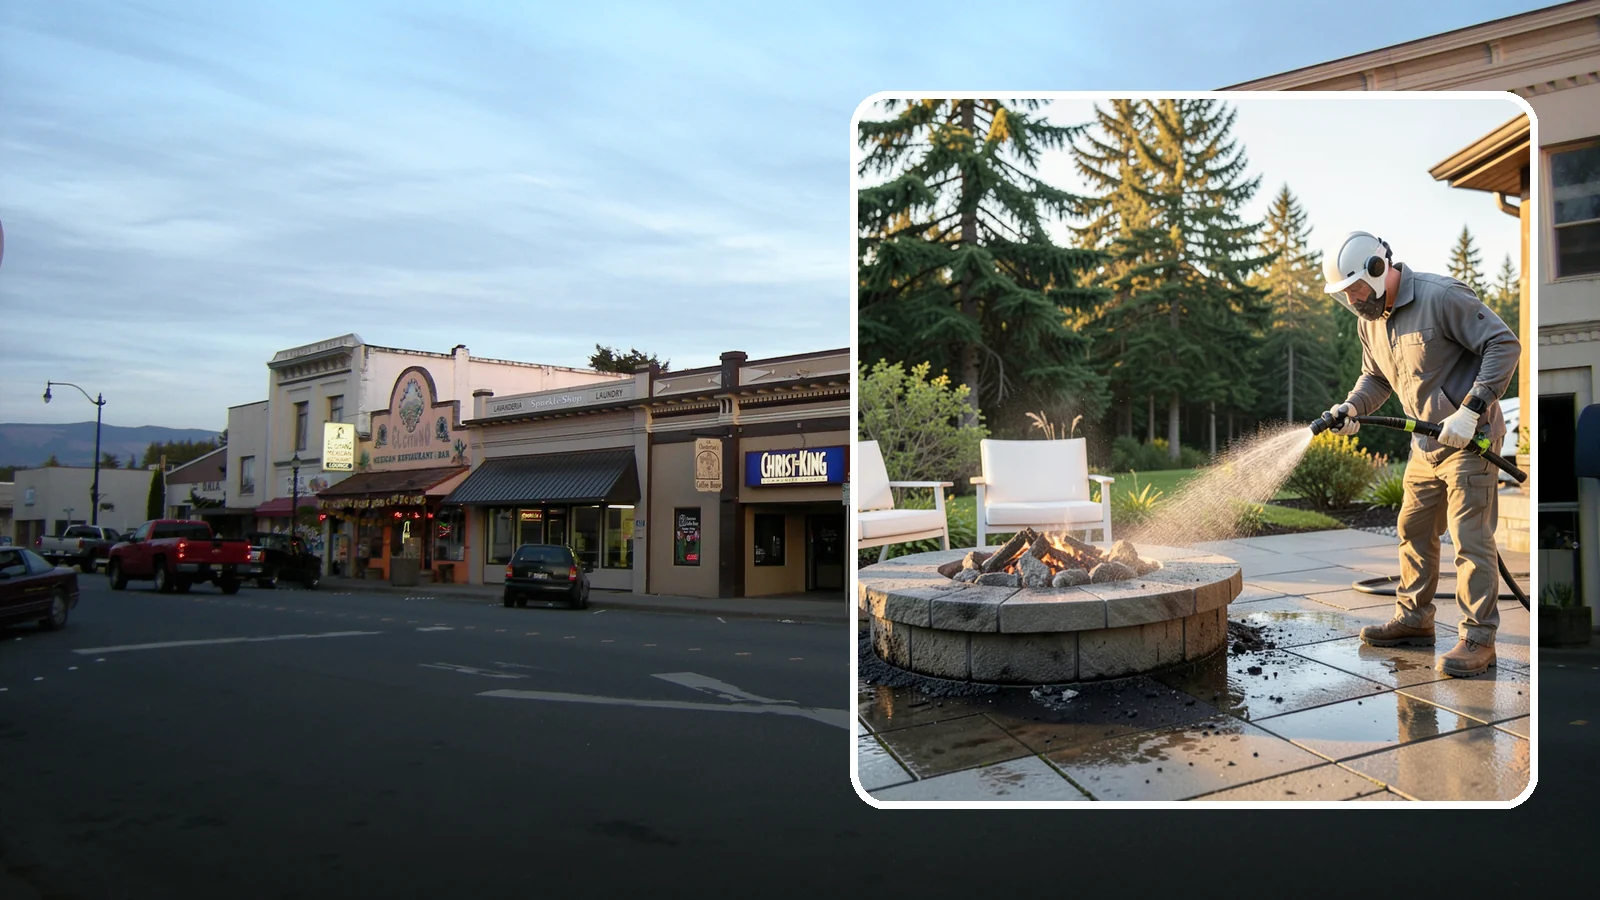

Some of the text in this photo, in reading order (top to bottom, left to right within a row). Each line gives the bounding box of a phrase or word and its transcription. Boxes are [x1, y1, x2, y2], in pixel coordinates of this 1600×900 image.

[493, 389, 623, 412] LAVANDERIA Sparkle Shop LAUNDRY
[374, 455, 396, 464] MEXICAN
[397, 451, 433, 462] RESTAURANT
[437, 450, 450, 459] BAR
[760, 450, 827, 477] CHRIST KING
